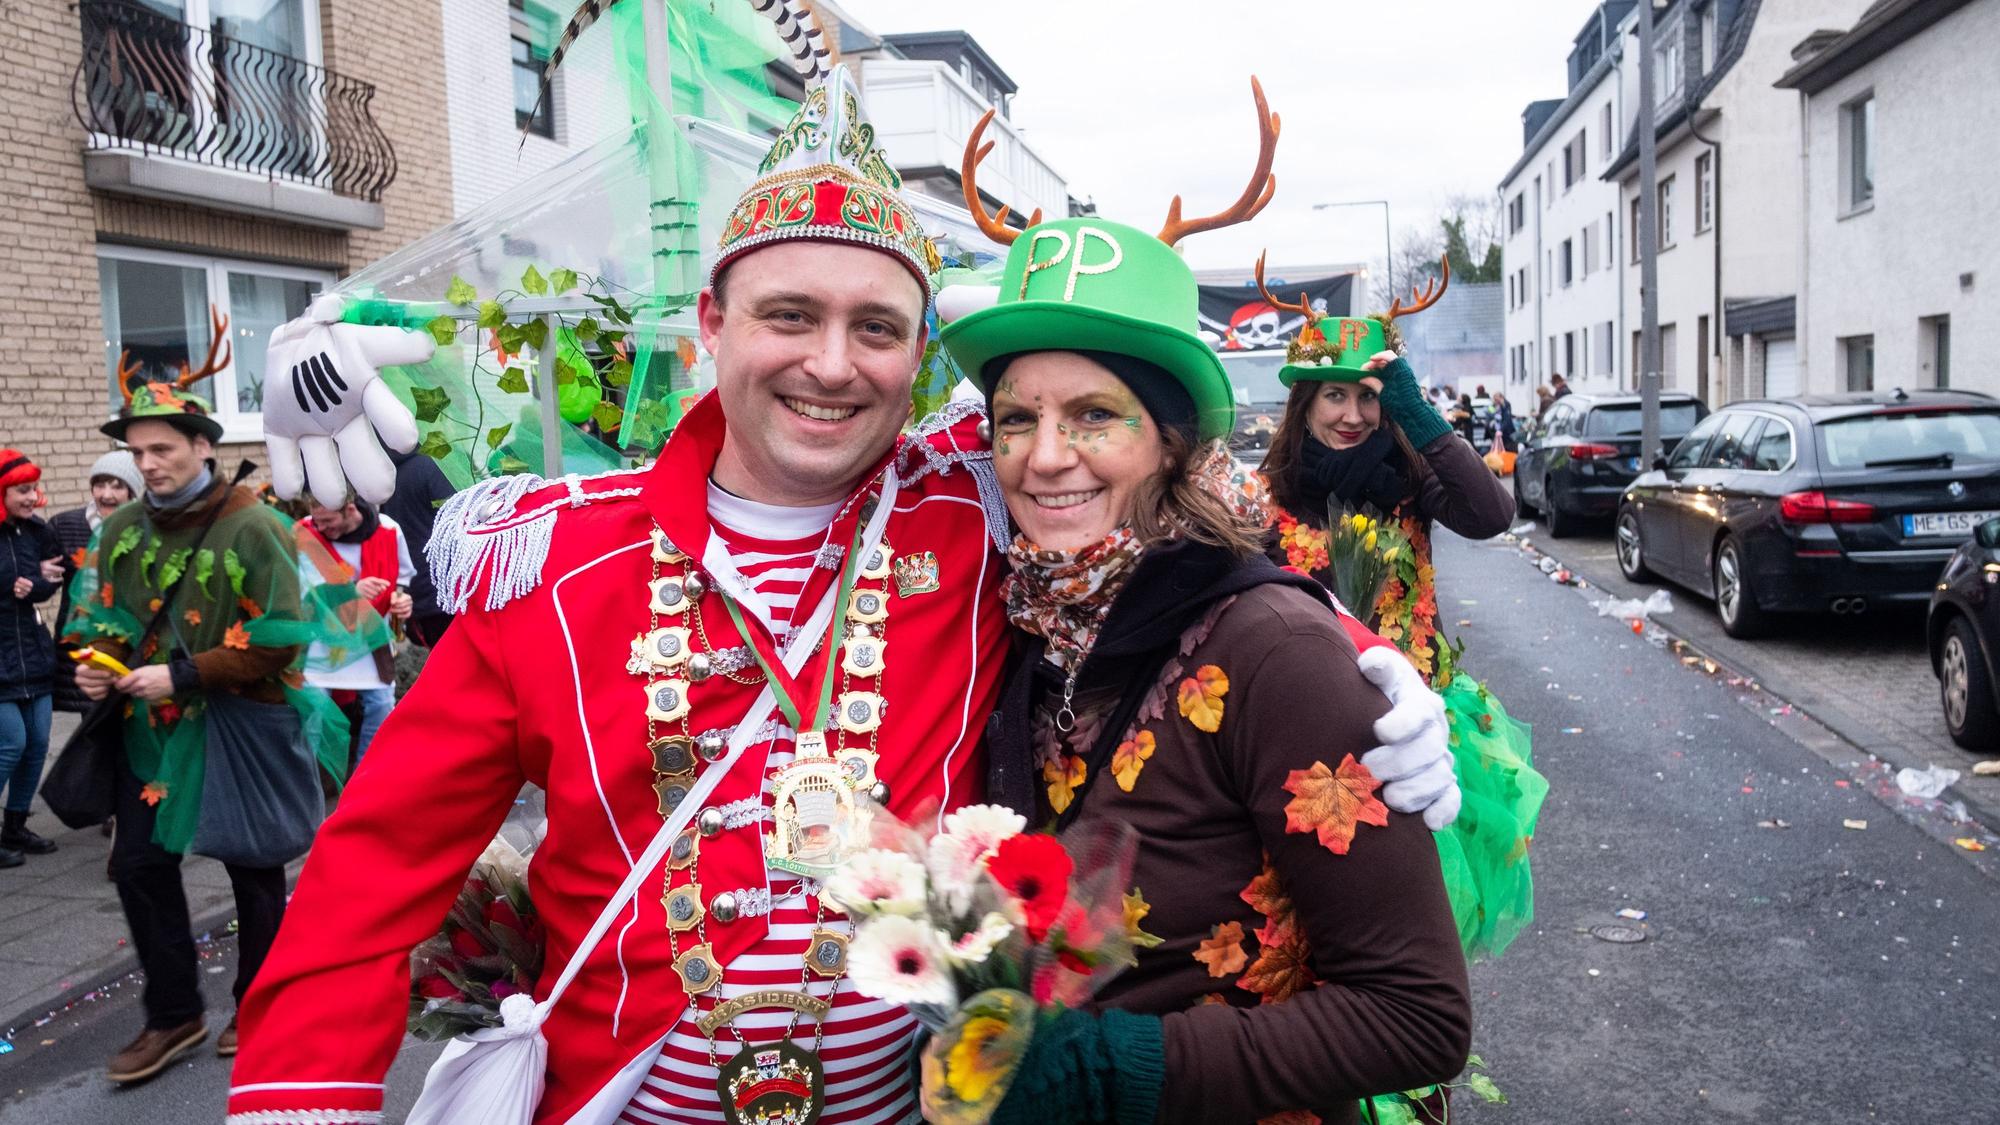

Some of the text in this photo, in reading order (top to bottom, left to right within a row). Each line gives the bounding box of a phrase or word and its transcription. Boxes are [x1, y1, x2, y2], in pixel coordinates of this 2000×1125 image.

[1019, 226, 1123, 303] PP
[1340, 319, 1369, 352] PP
[1914, 515, 1936, 531] ME
[1947, 513, 1969, 530] GS
